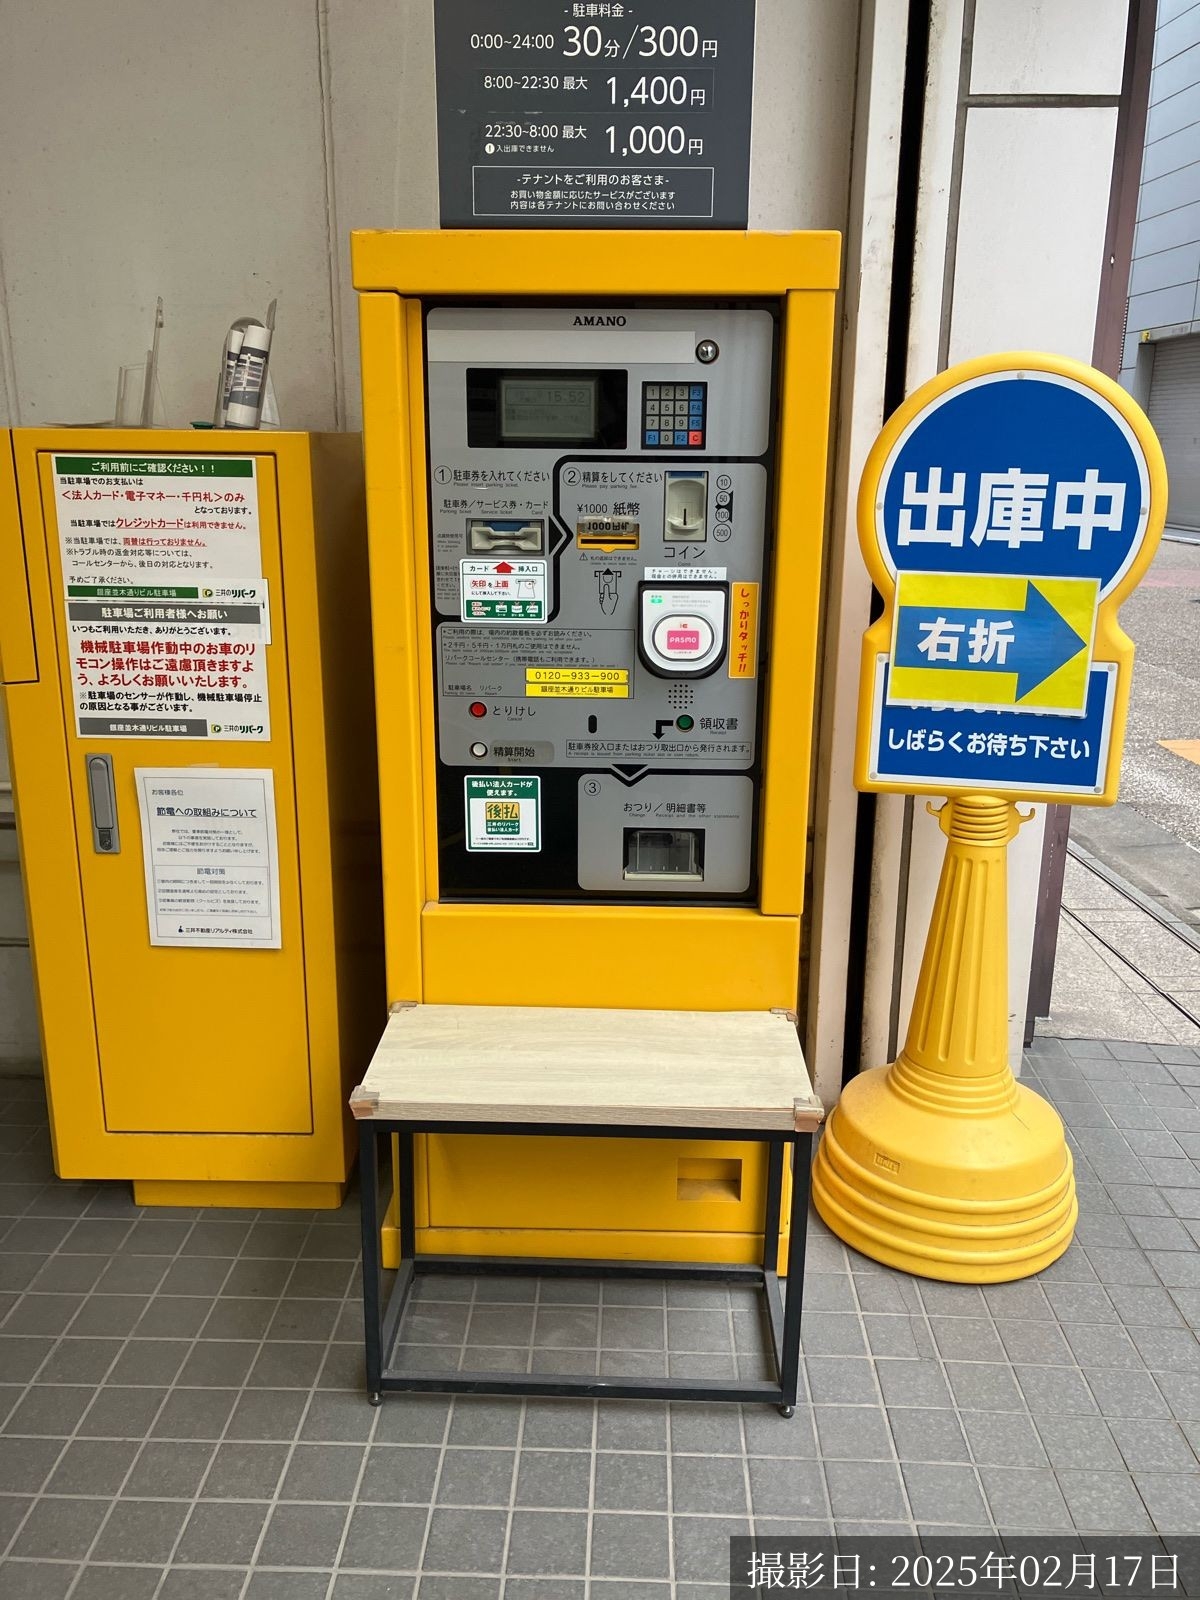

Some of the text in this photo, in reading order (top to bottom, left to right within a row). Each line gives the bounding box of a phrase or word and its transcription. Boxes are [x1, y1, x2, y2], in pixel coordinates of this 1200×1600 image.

[572, 3, 625, 17] 駐車料金
[563, 76, 588, 90] 最大
[606, 76, 705, 108] 1,400円
[562, 125, 587, 139] 最大
[606, 126, 703, 156] 1,000円
[510, 190, 676, 200] お買い物金額に応じたサービスがございます
[510, 201, 675, 211] 内容は各テナントにお問い合わせください
[573, 316, 627, 326] AMANO
[60, 477, 143, 486] 当駐車場でのお支払いは
[453, 470, 550, 482] 駐車券を入れてください
[582, 472, 662, 484] 精算をしてください
[194, 506, 251, 515] となっております。
[613, 502, 640, 516] 紙幣
[897, 467, 1126, 550] 出庫中
[664, 546, 706, 559] コイン
[101, 608, 228, 619] 駐車場ご利用者様へお願い
[80, 640, 255, 655] 機械駐車場作動中のお車のリ
[916, 617, 1015, 665] 右折
[76, 658, 254, 672] モコン操作はご遠慮頂きますよ
[77, 674, 249, 689] う、よろしくお願いいたします。
[80, 703, 193, 712] の原因となる事がございます。
[493, 706, 536, 717] とりけし
[700, 717, 739, 730] 領収書
[888, 728, 1090, 760] しばらくお待ち下さい
[493, 746, 535, 758] 精算開始
[156, 806, 257, 818] 節電への取組みについて
[487, 804, 518, 818] 後払
